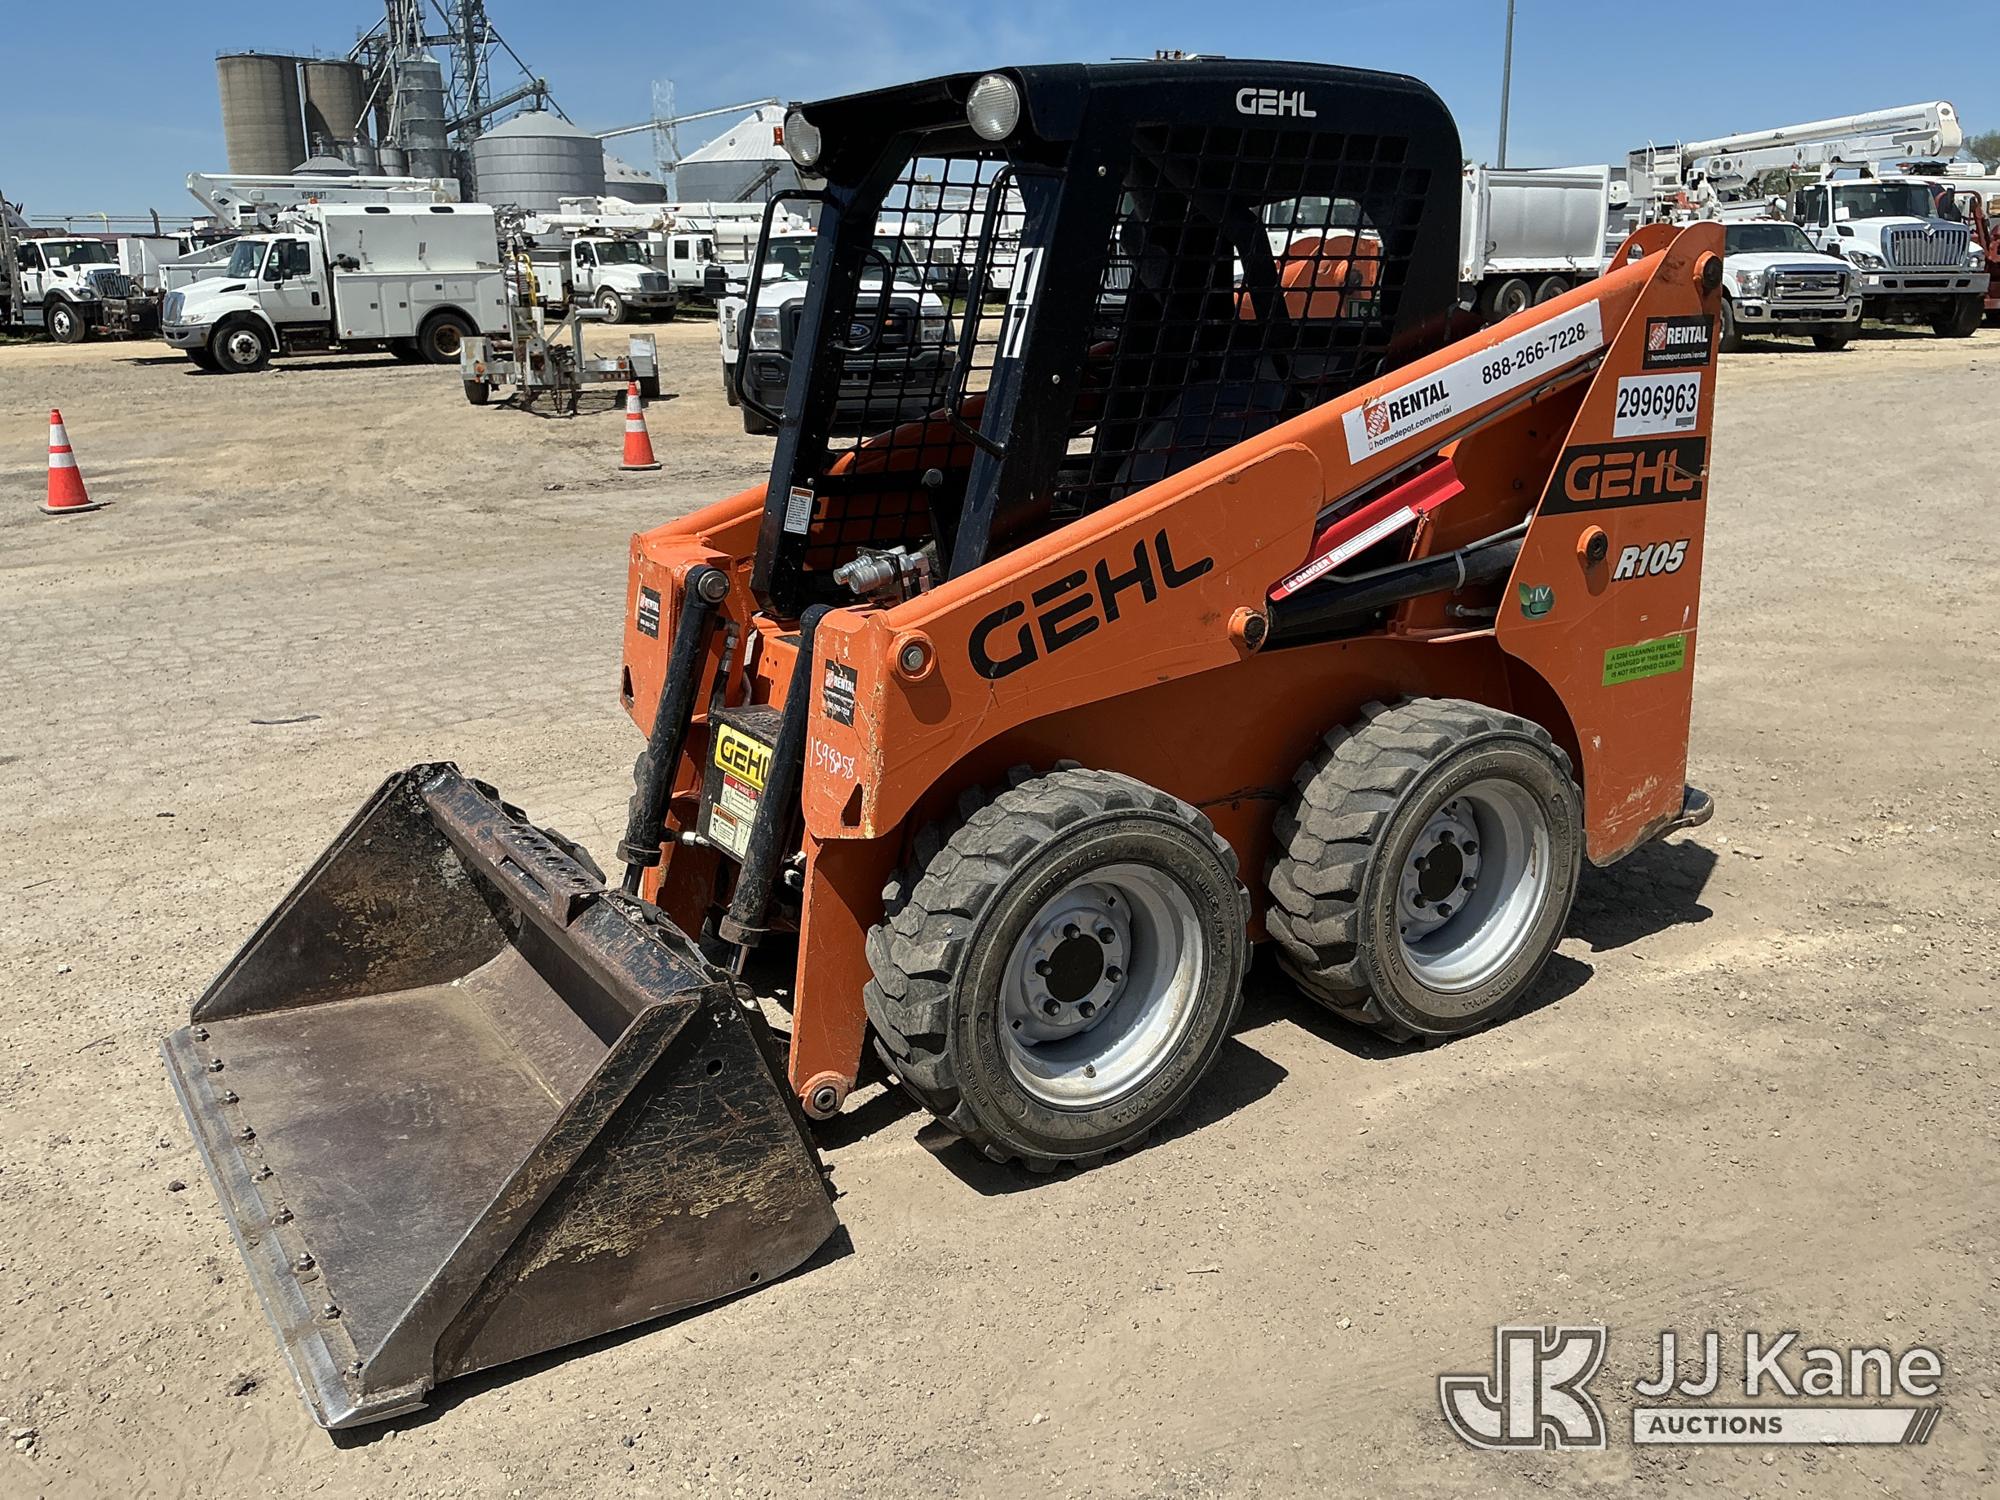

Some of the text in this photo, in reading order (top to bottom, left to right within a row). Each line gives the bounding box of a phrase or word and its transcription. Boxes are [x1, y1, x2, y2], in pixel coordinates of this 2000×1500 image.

[1236, 88, 1317, 118] GEHL
[1482, 322, 1586, 385] 888-266-7228
[1667, 326, 1708, 344] RENTAL
[1389, 380, 1449, 423] RENTAL
[1617, 383, 1697, 418] 2996963
[1374, 405, 1452, 448] homedepot.com/rental
[1565, 449, 1693, 501] GEHL
[1611, 538, 1691, 582] R105
[968, 528, 1214, 680] GEHL
[809, 736, 855, 779] 1598258
